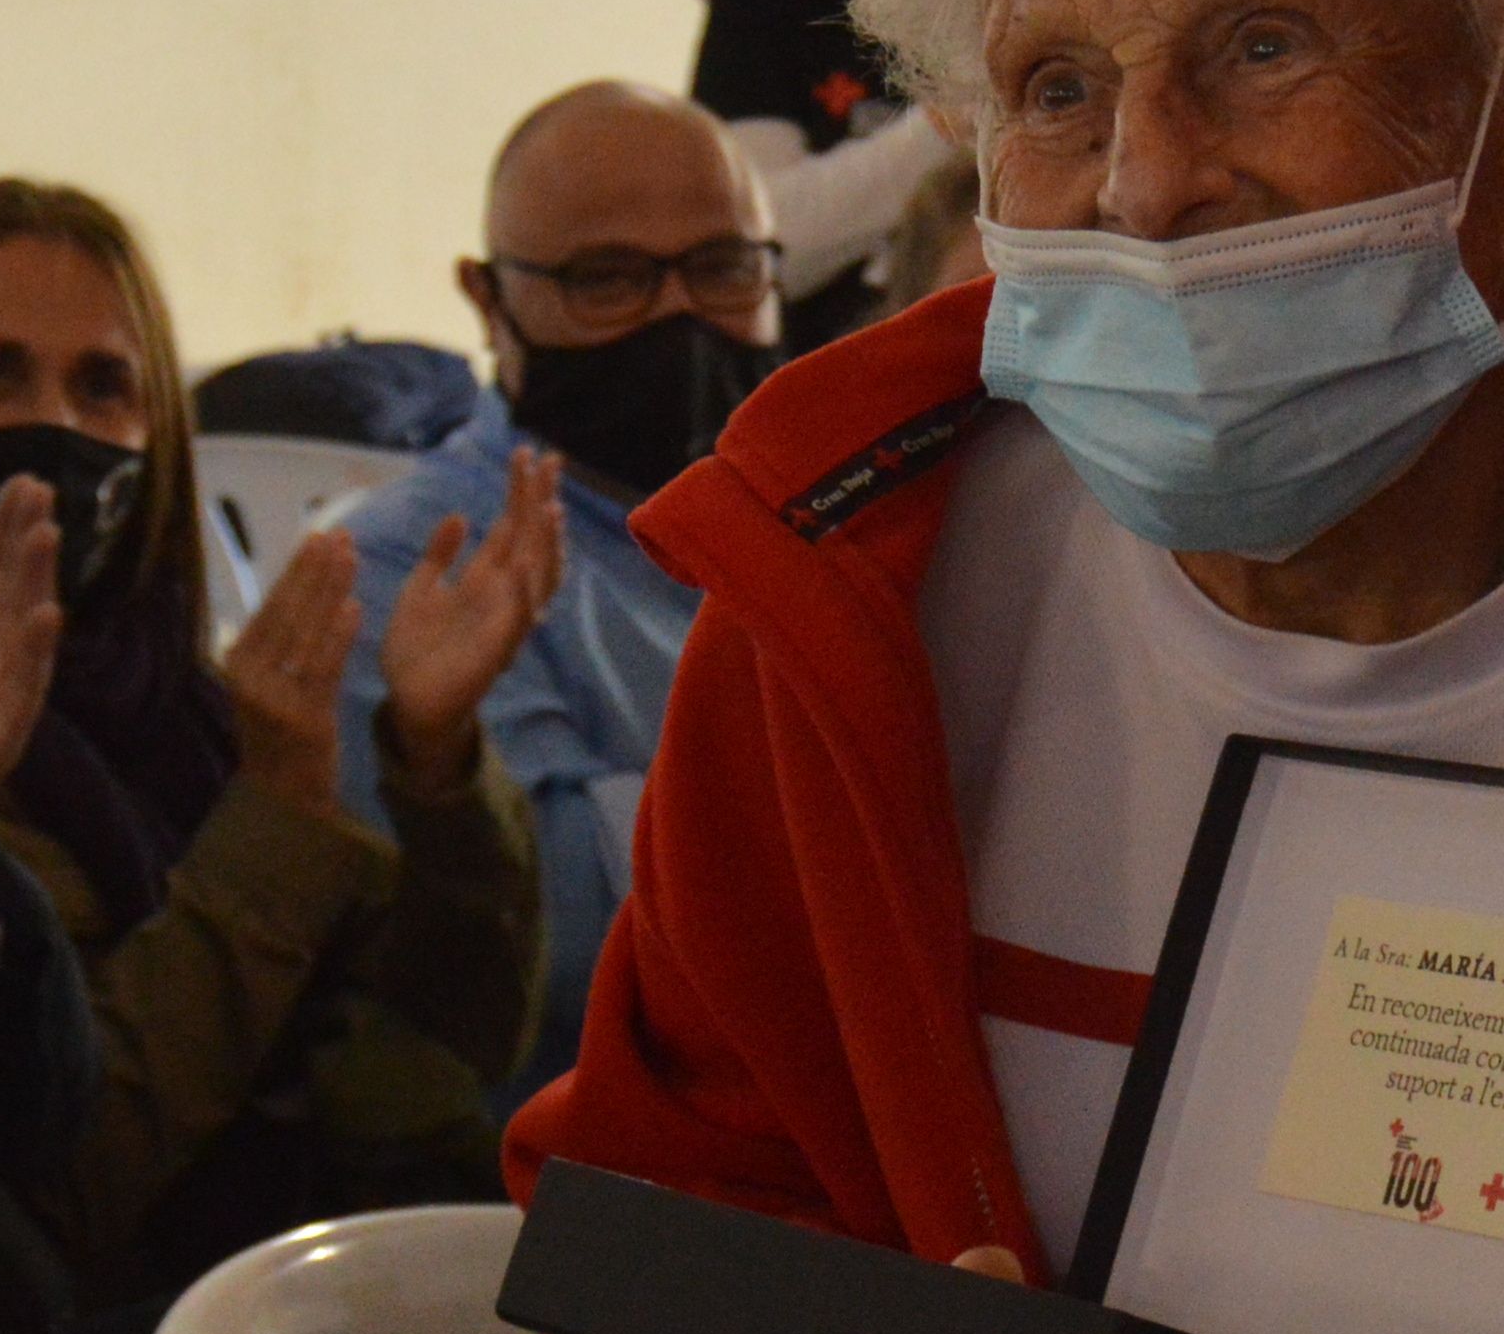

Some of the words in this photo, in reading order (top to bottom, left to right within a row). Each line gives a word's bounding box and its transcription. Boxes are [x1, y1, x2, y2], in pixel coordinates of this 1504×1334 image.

[1334, 938, 1347, 958] A
[1354, 937, 1370, 961] la
[1417, 950, 1496, 982] MARÍA
[1347, 982, 1376, 1014] En
[1349, 1028, 1471, 1066] continuada
[1385, 1070, 1458, 1102] suport
[1460, 1085, 1474, 1103] a
[1382, 1151, 1443, 1213] 100
